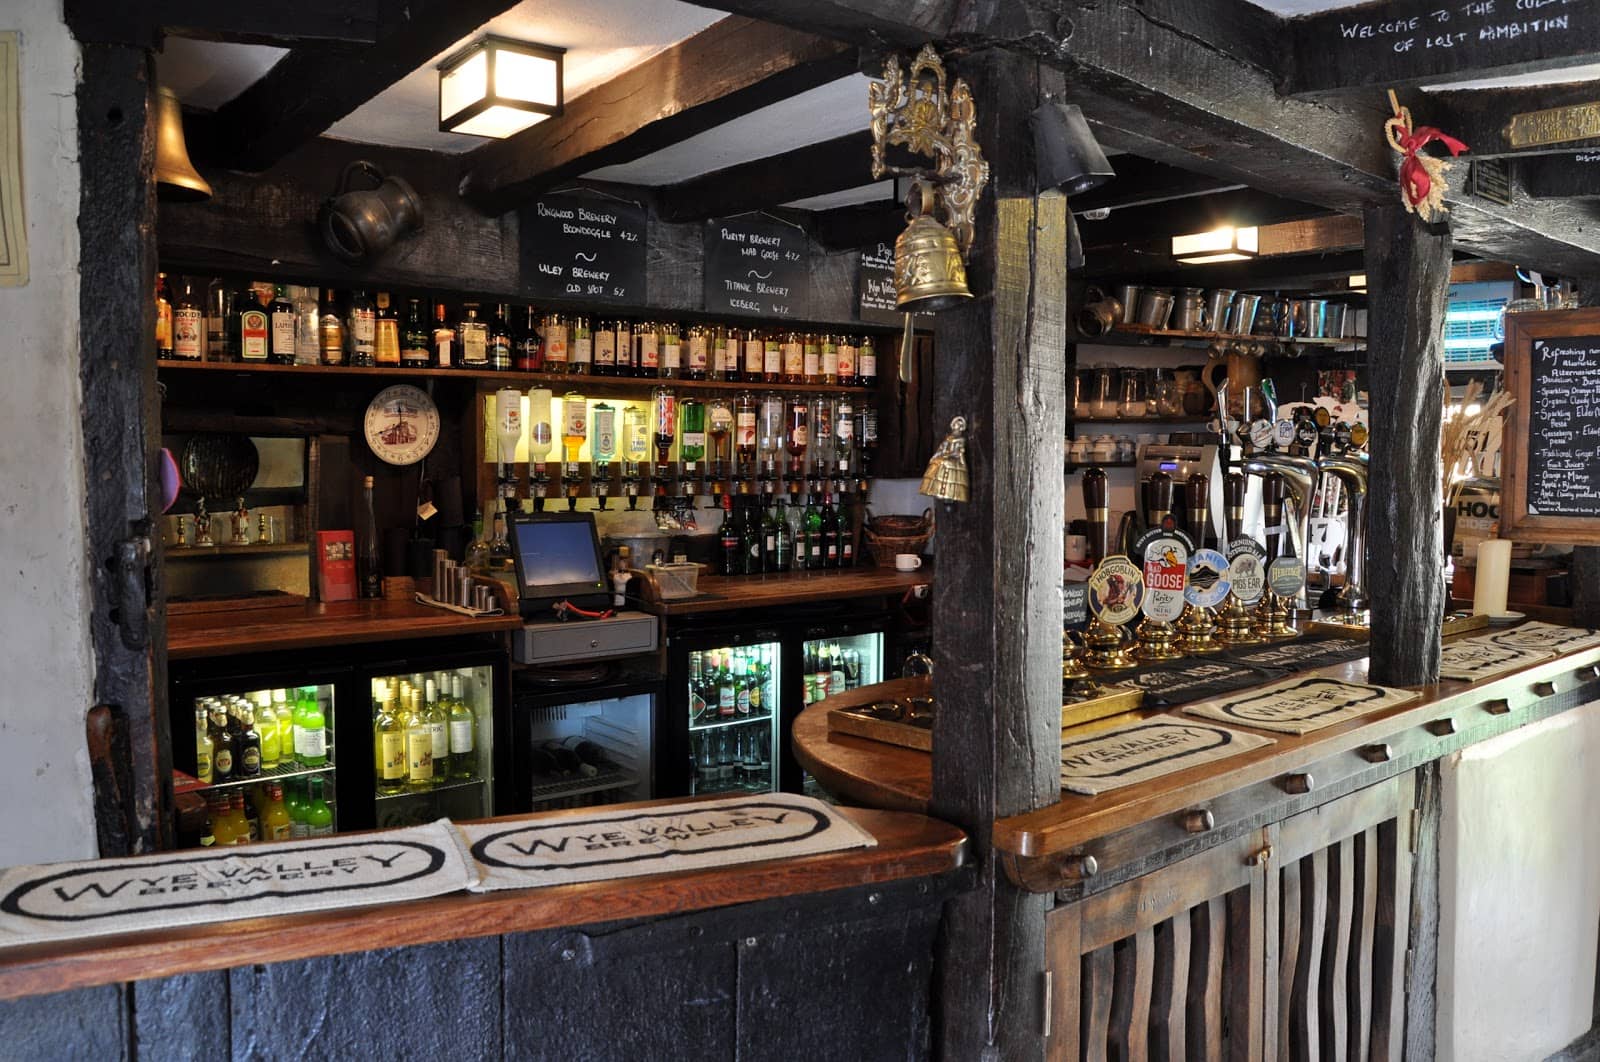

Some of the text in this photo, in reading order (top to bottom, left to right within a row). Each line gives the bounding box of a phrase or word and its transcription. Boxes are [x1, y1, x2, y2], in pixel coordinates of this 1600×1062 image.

[1340, 17, 1419, 38] WELCOME
[1431, 10, 1449, 22] TO
[1462, 2, 1495, 17] THE
[1393, 39, 1415, 52] OF
[578, 208, 617, 224] BREWERY
[721, 228, 781, 247] PURITY BREWERY
[741, 247, 757, 257] MAD
[761, 248, 779, 261] GOOSE
[572, 266, 610, 282] BREWERY
[756, 282, 789, 297] BREWERY
[1096, 564, 1136, 583] HOBGOBLIN
[1146, 572, 1183, 589] GOOSE
[1232, 577, 1261, 589] PIGS EAR
[1153, 590, 1174, 606] Purity
[1111, 728, 1201, 751] VALLEY
[1101, 737, 1191, 763] BREWERY
[506, 812, 790, 856] WYE VALLEY
[52, 850, 408, 902] WYE VALLEY
[138, 866, 360, 896] BREWERY
